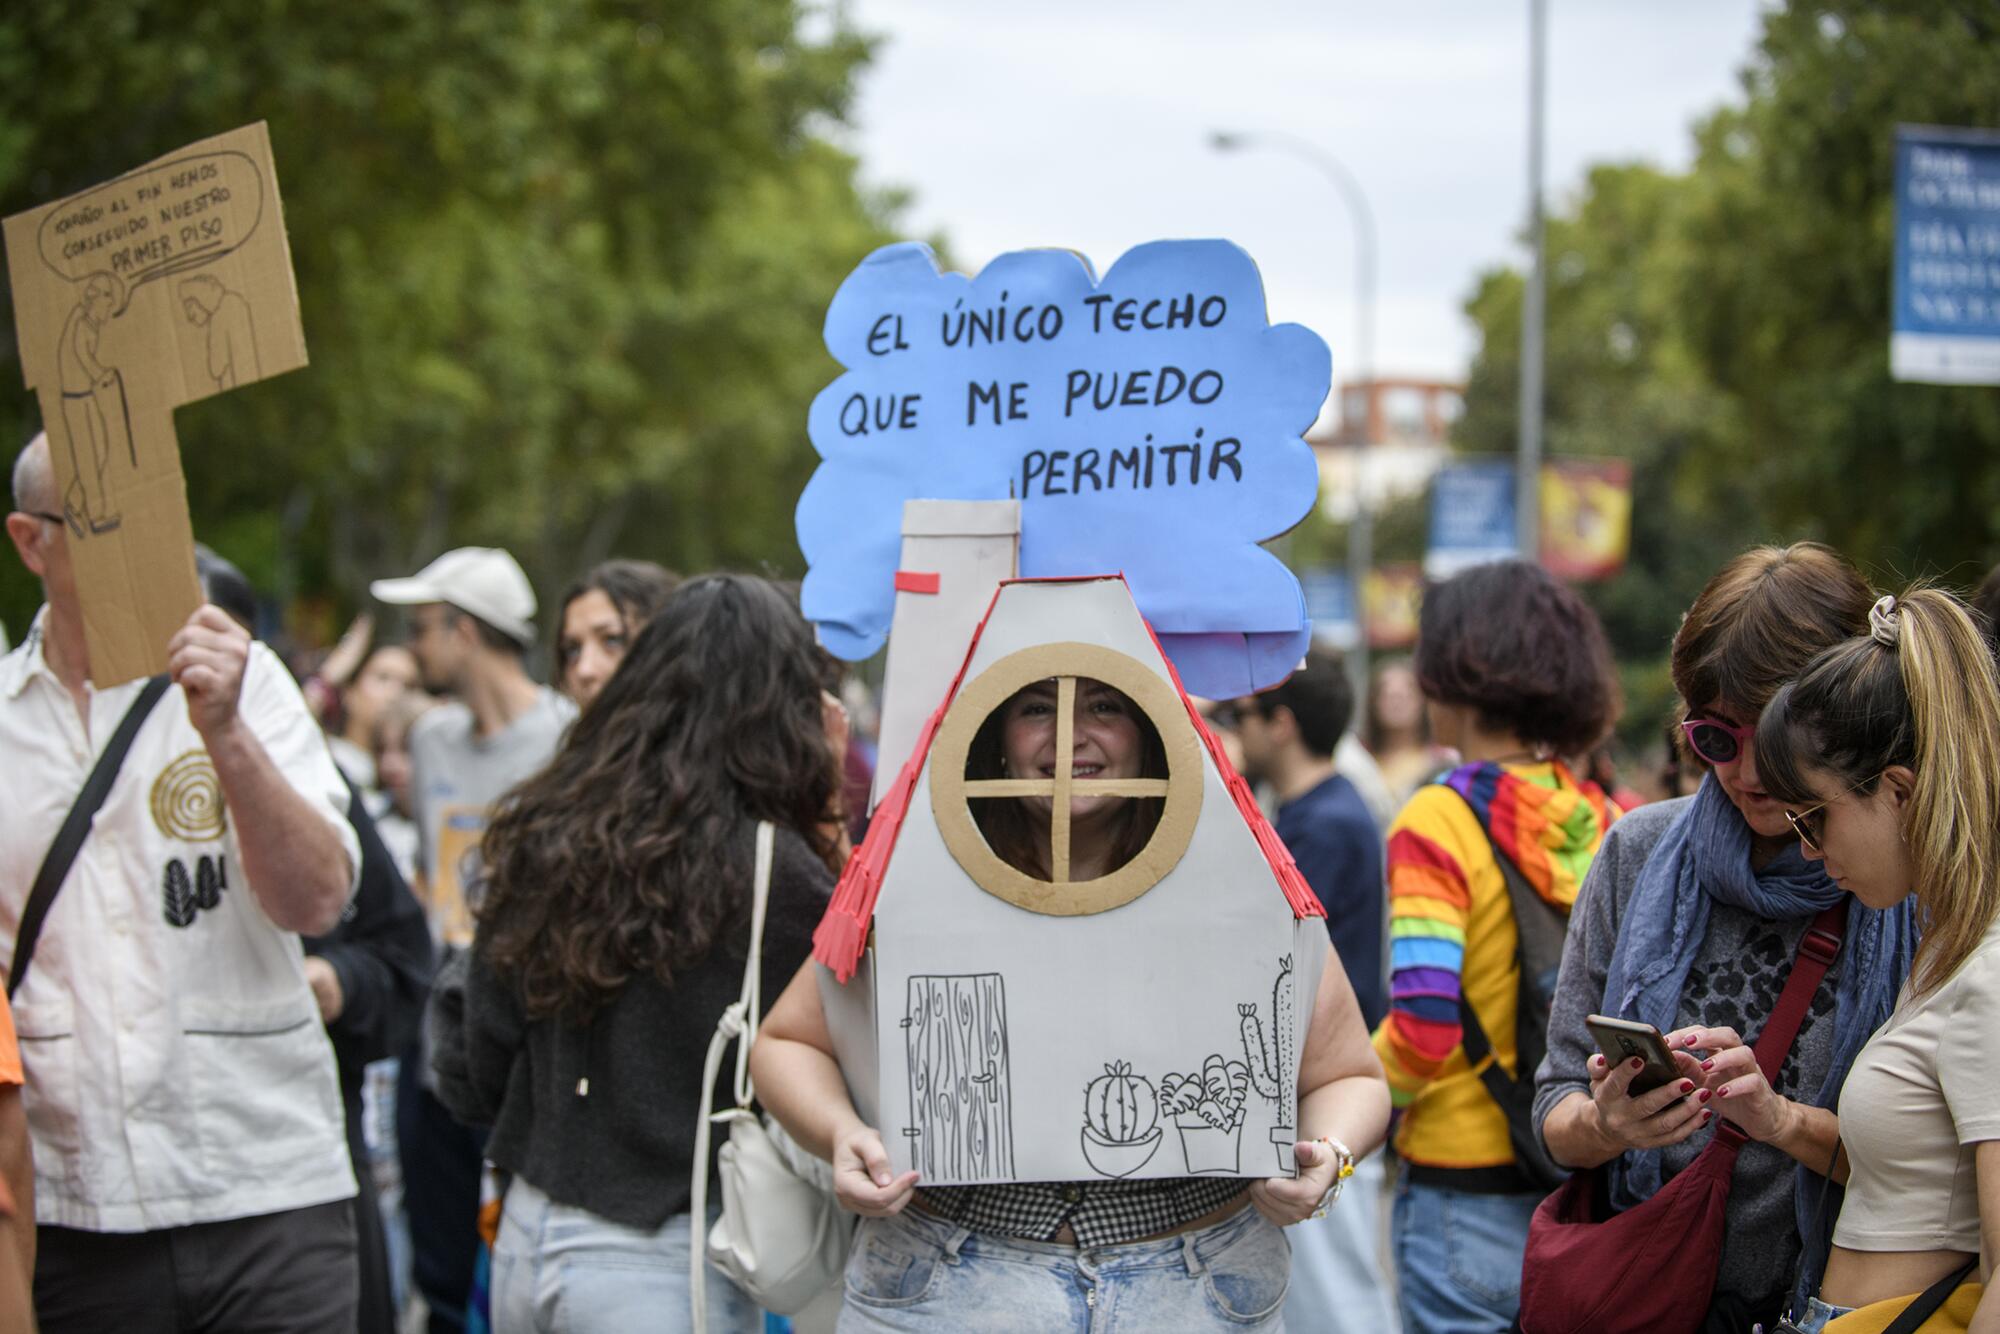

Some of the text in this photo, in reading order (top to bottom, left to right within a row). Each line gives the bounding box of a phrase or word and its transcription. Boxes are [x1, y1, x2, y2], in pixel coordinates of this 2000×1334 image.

[111, 198, 129, 213] AL
[137, 185, 161, 203] FIN
[171, 163, 217, 188] HEMOS
[63, 186, 231, 259] CONSEGUIDO NUESTRO
[111, 217, 222, 272] PRIMER PISO
[866, 313, 909, 356] EL
[1084, 293, 1227, 334] TECHO
[839, 366, 1225, 436] QUE ME PUEDO
